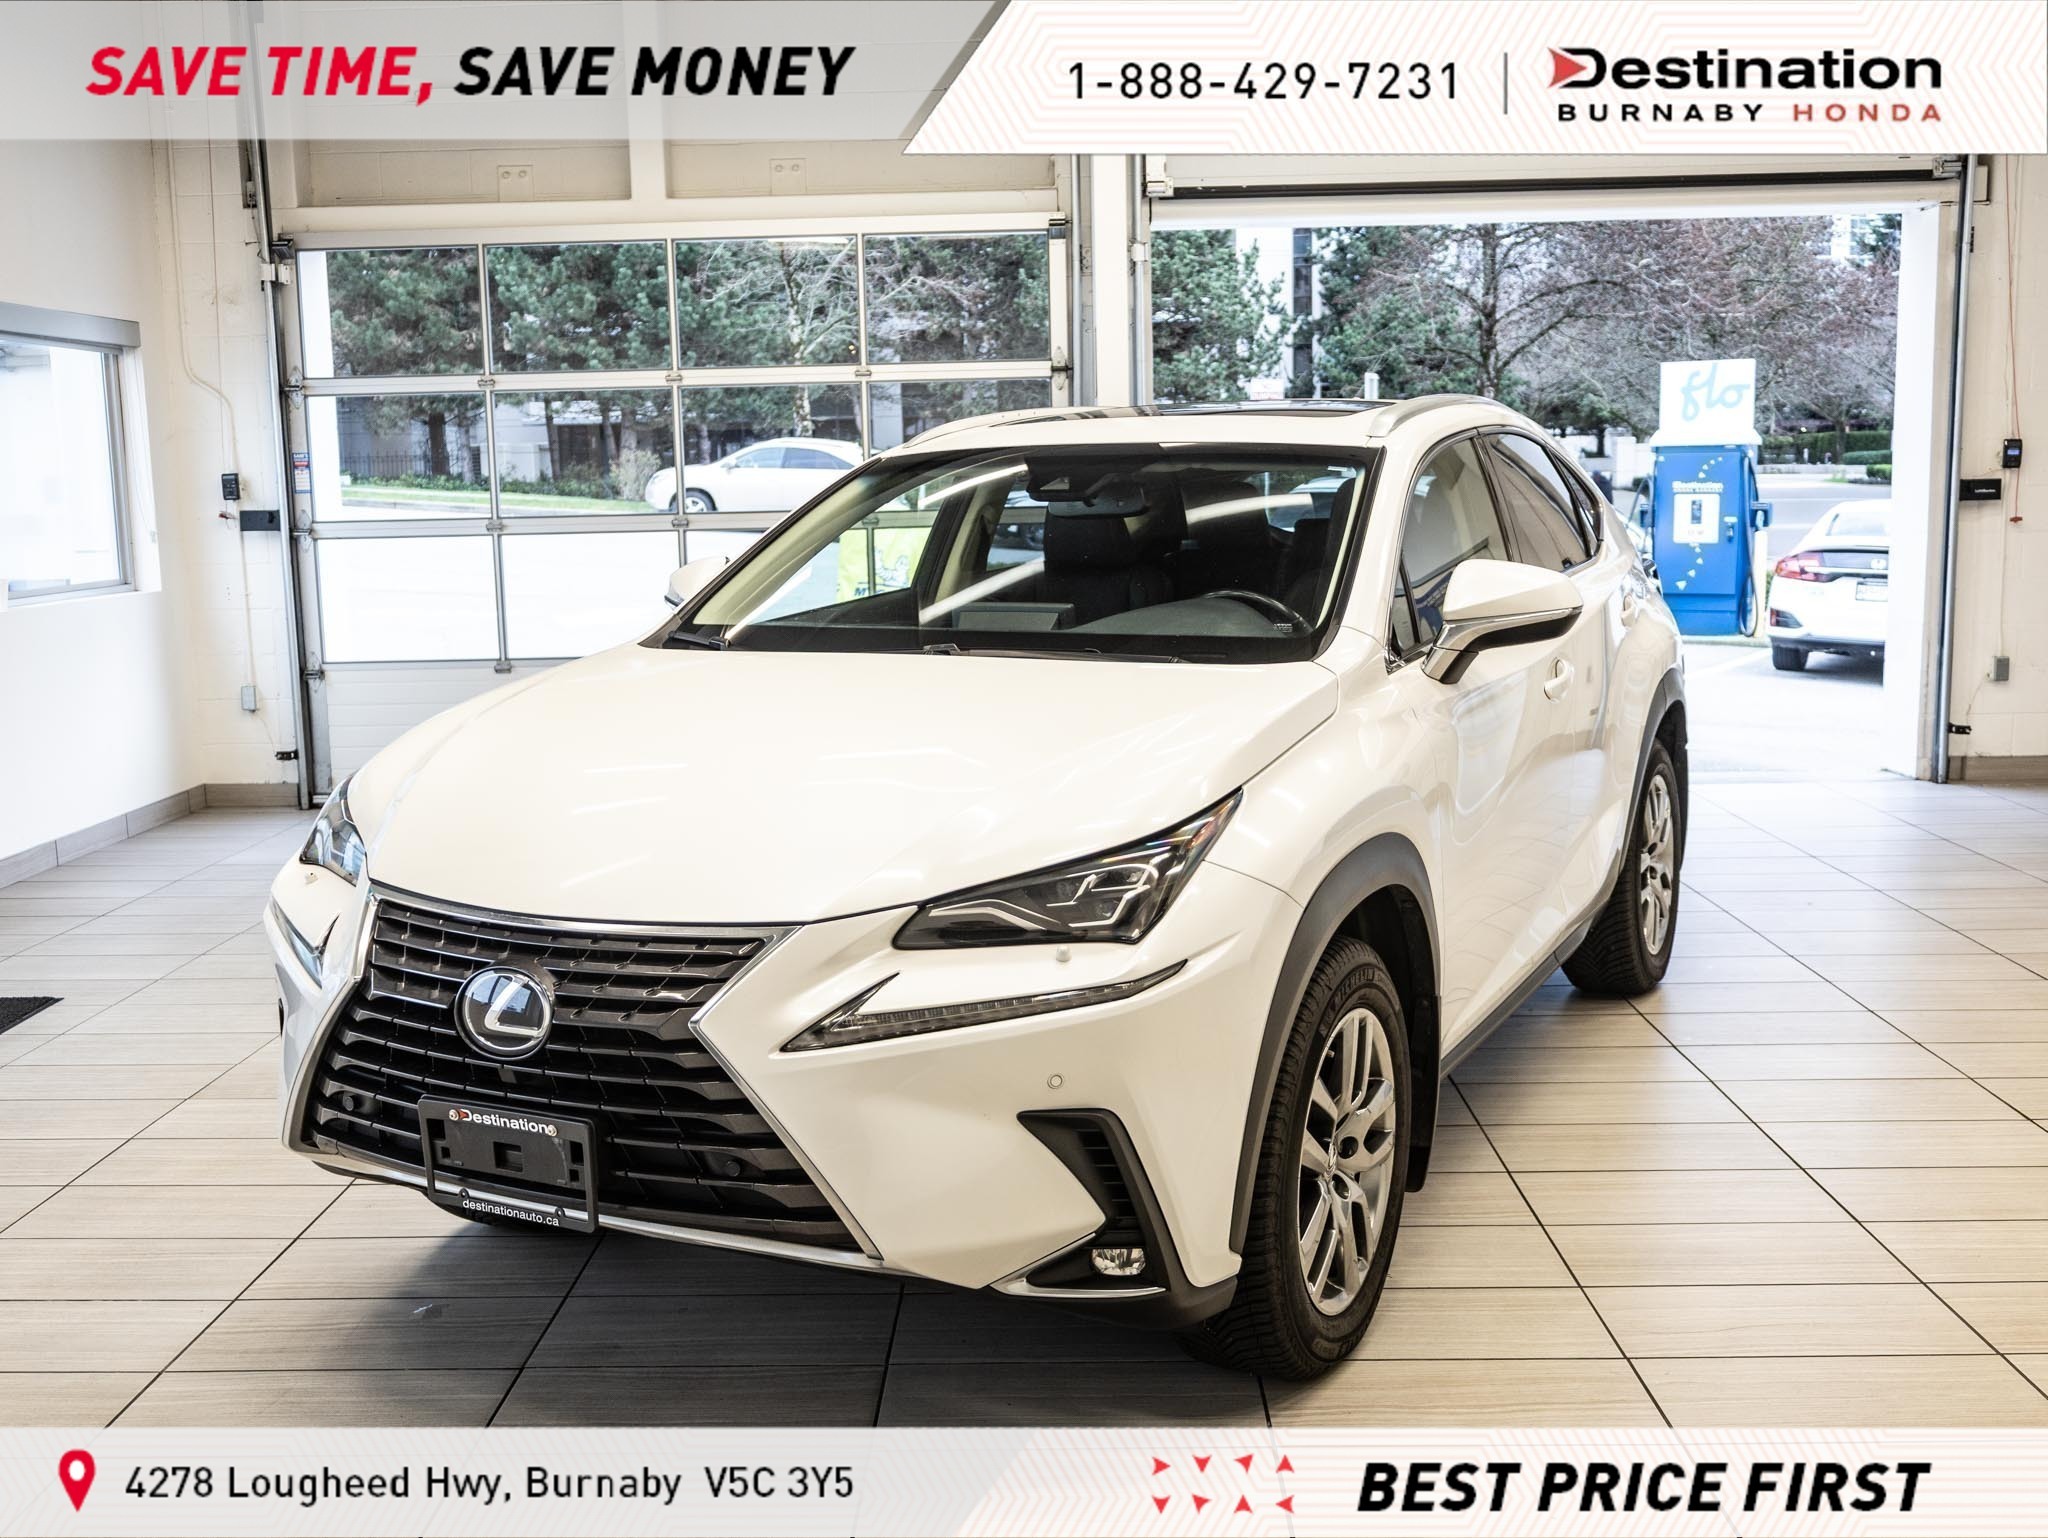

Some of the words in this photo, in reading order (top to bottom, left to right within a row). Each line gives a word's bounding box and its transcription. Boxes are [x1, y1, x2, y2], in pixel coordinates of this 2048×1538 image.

[1680, 362, 1750, 421] flo
[459, 1108, 549, 1134] Destination
[462, 1199, 560, 1226] destinationauto.ca
